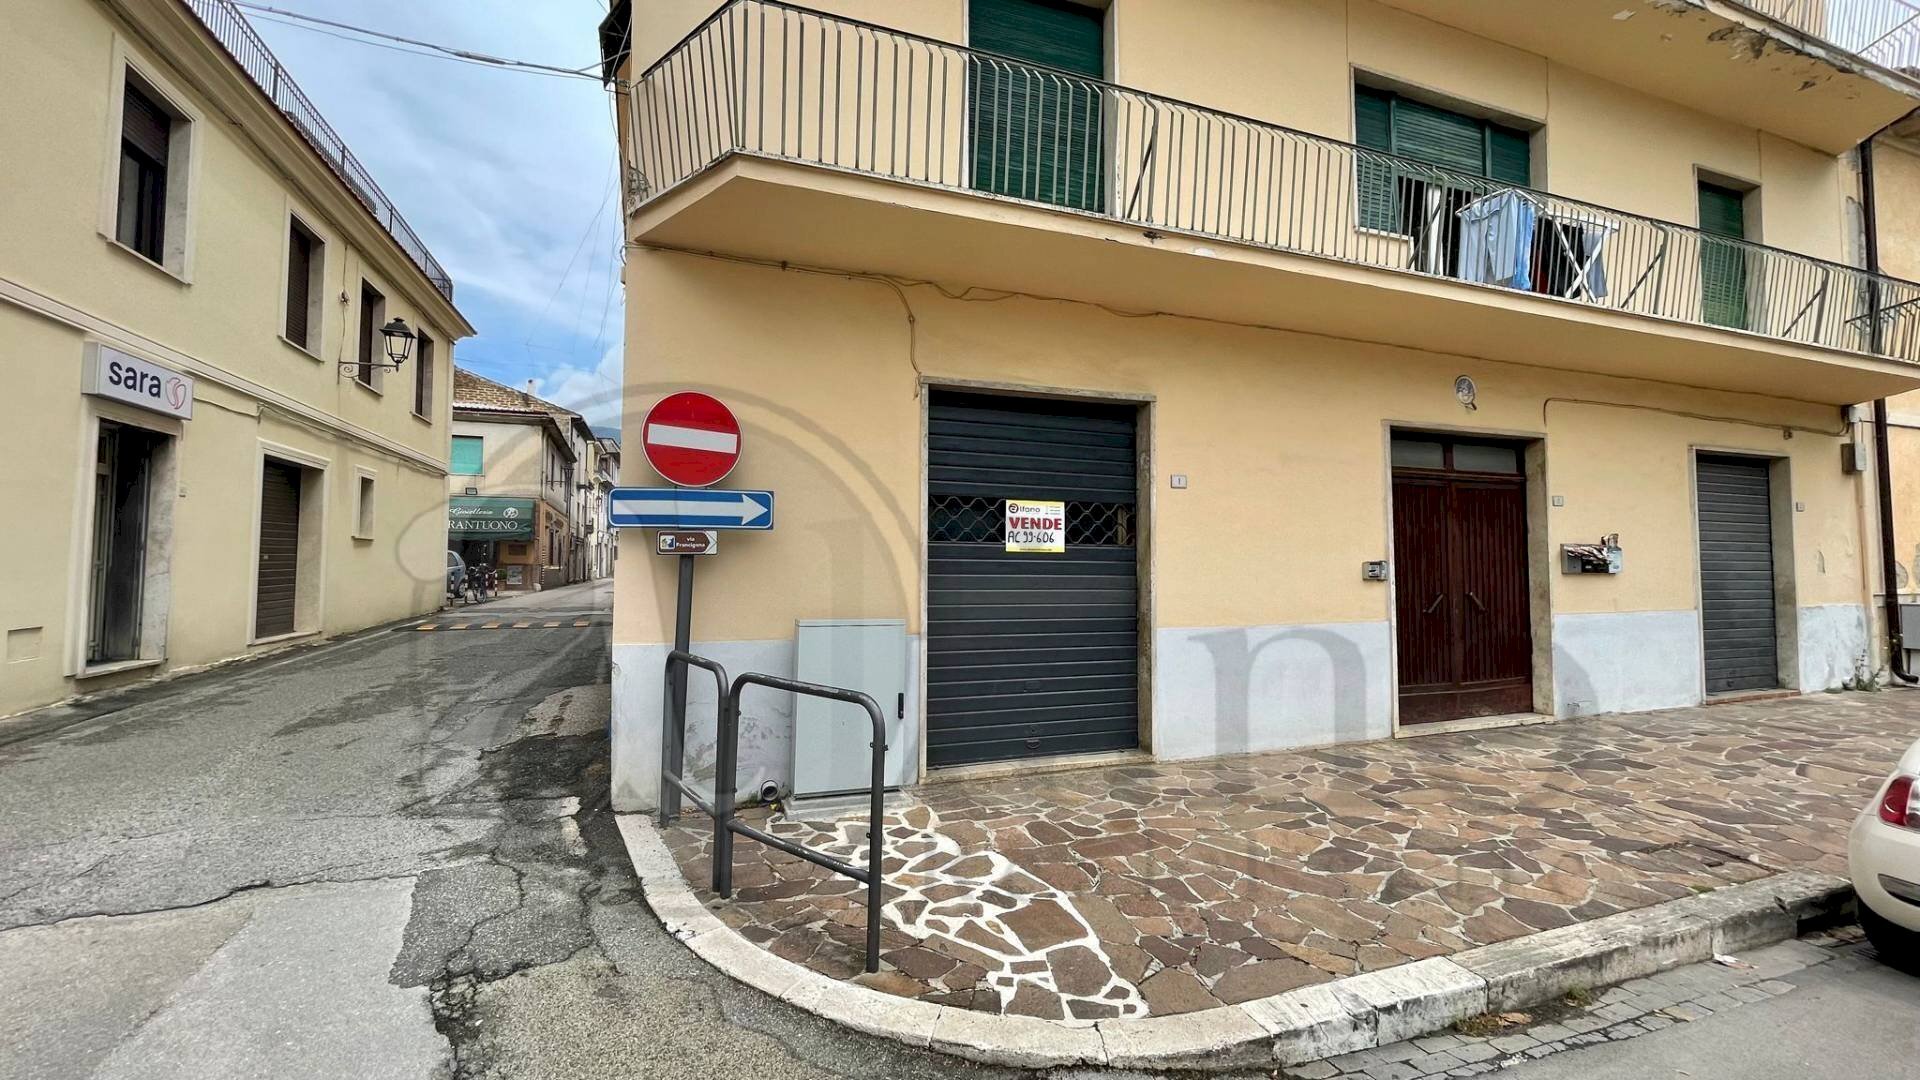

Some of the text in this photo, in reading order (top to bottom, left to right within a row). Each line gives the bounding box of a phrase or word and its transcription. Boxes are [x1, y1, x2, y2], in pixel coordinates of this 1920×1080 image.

[109, 361, 161, 398] sara
[1008, 516, 1063, 531] VENDE
[1007, 530, 1021, 543] AC
